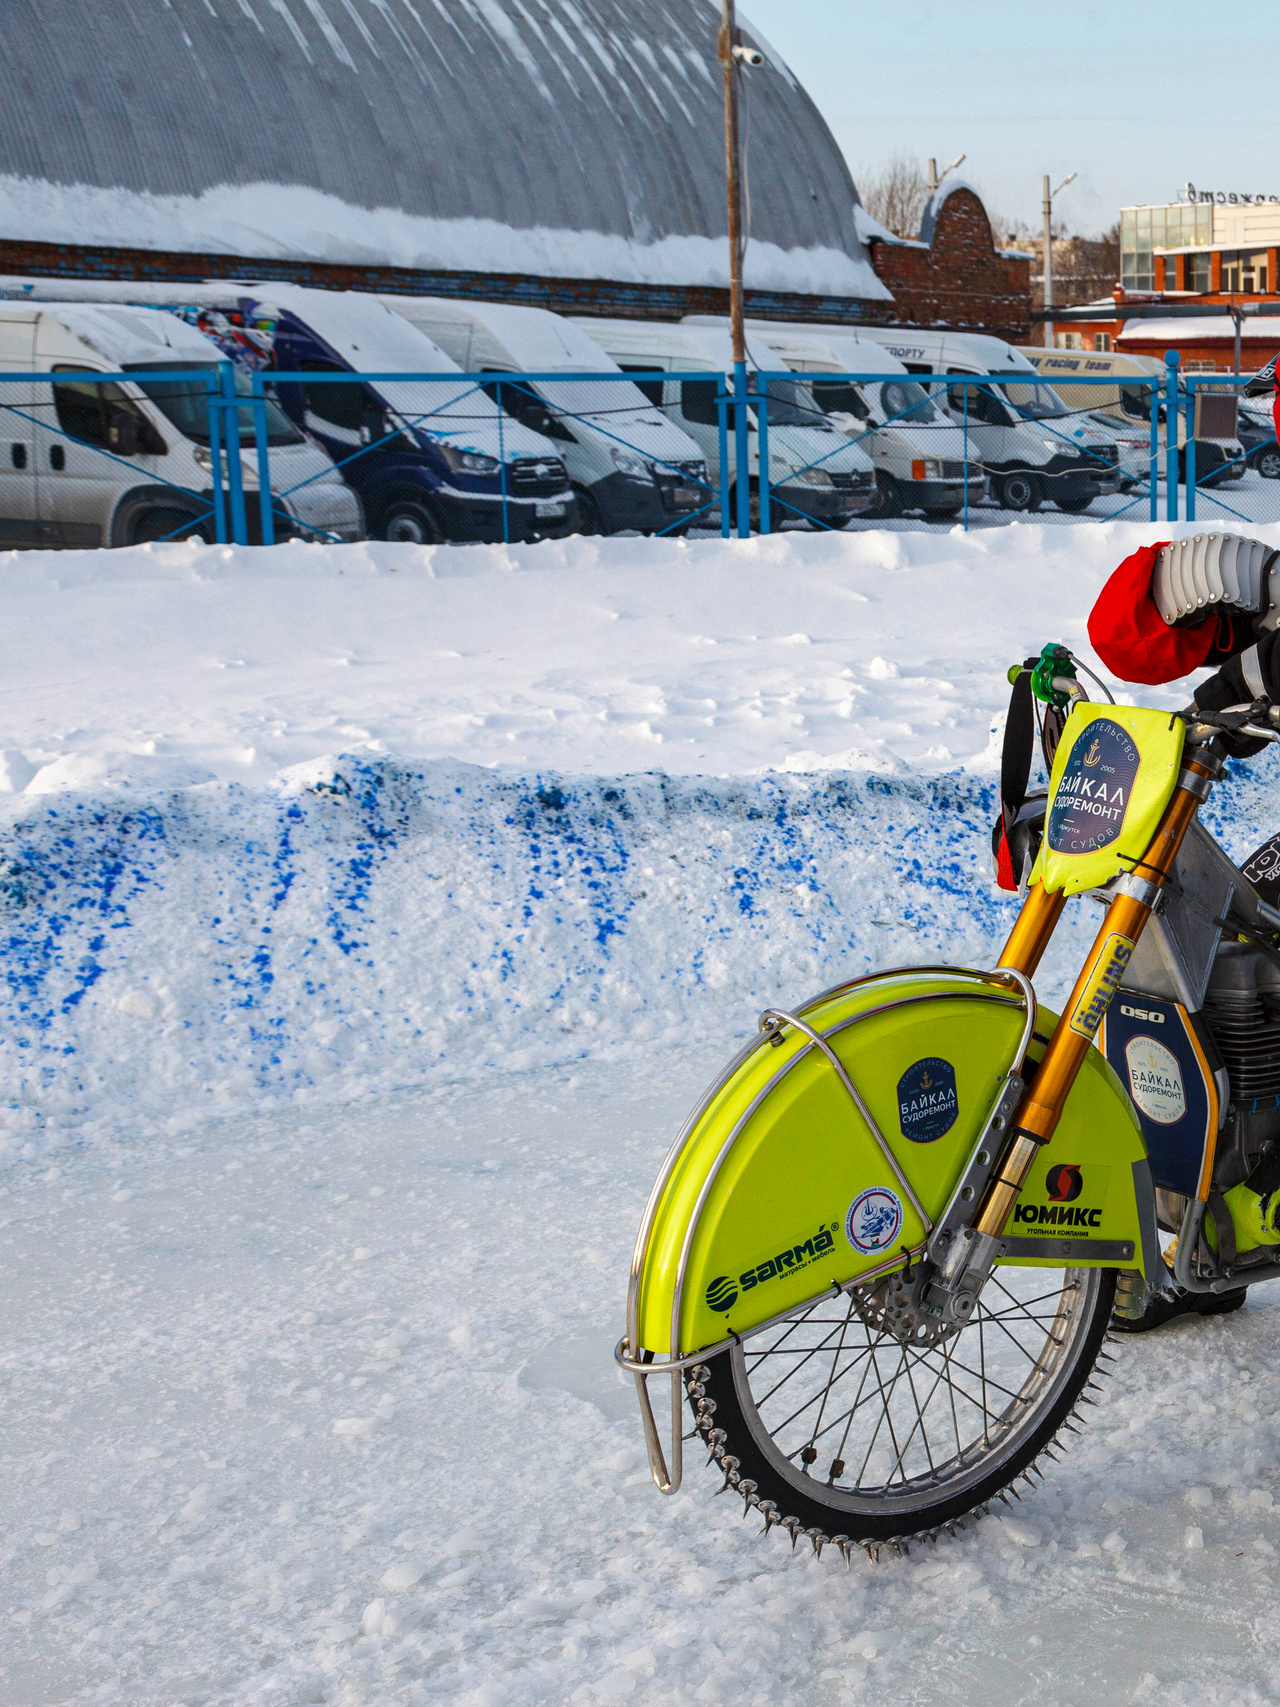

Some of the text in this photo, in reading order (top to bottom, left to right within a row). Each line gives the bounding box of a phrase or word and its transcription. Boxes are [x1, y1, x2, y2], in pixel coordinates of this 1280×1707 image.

[884, 346, 926, 358] ПОРТУ
[1084, 360, 1112, 371] team
[1100, 764, 1116, 774] 2005
[1059, 772, 1124, 806] БАЙКАЛ
[1070, 827, 1114, 849] СУДОВ
[1120, 1004, 1165, 1024] OSO
[1131, 1069, 1181, 1092] БАЙКАЛ
[1133, 1082, 1182, 1100] СУДОРЕМОНТ
[900, 1087, 956, 1115] БАЙКАЛ
[902, 1099, 956, 1124] СУДОРЕМОНТ
[1014, 1203, 1103, 1227] ЮМИКС
[1027, 1228, 1056, 1236] УГОЛЬНАЯ
[779, 1246, 836, 1280] матрасы мебель
